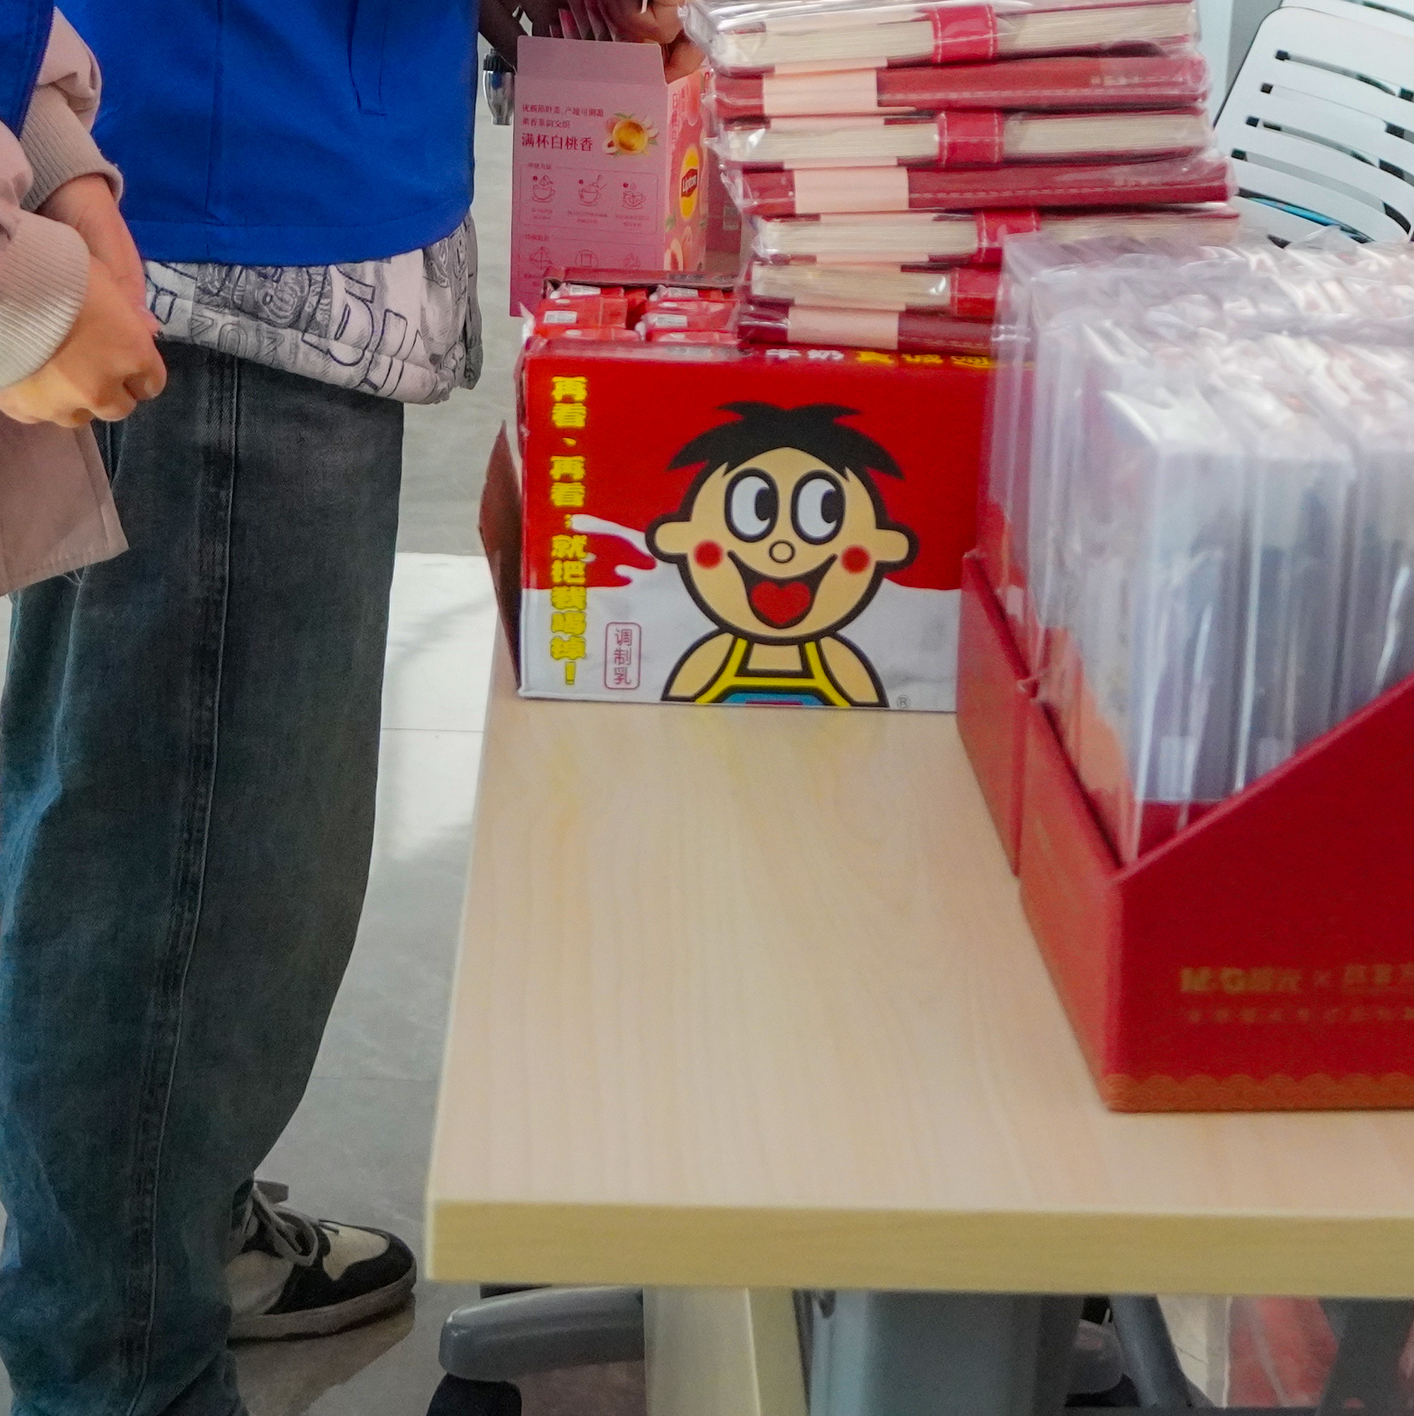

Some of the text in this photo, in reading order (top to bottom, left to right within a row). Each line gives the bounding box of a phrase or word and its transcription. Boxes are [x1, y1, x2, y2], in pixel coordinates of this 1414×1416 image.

[521, 132, 593, 152] 满杯白桃香
[614, 629, 633, 685] 调制乳
